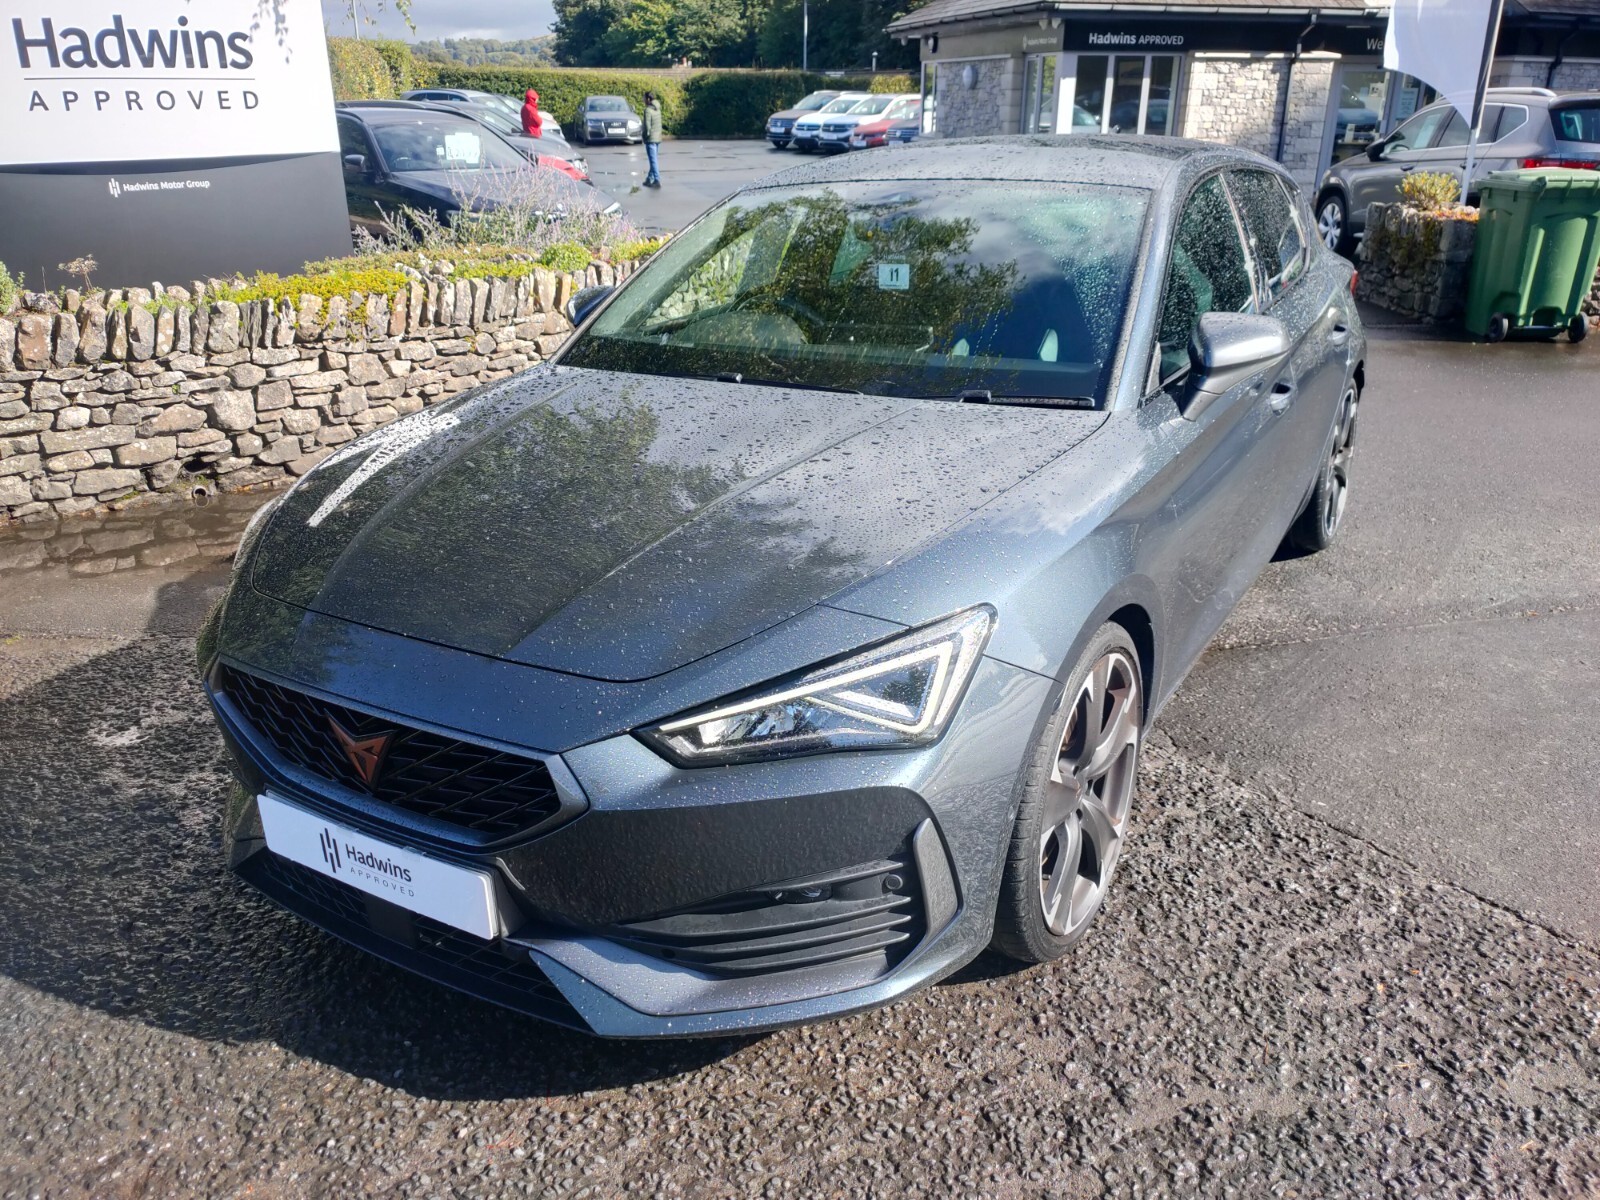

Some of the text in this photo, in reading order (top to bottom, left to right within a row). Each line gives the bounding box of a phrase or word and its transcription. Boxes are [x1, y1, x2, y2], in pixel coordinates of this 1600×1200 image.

[11, 14, 254, 70] Hadwins
[1088, 32, 1184, 45] Hadwins APPROVED
[28, 89, 260, 112] APPROVED
[123, 180, 210, 191] Hadwins Motor Group
[345, 843, 412, 883] Hadwins
[350, 866, 415, 897] APPROVED
